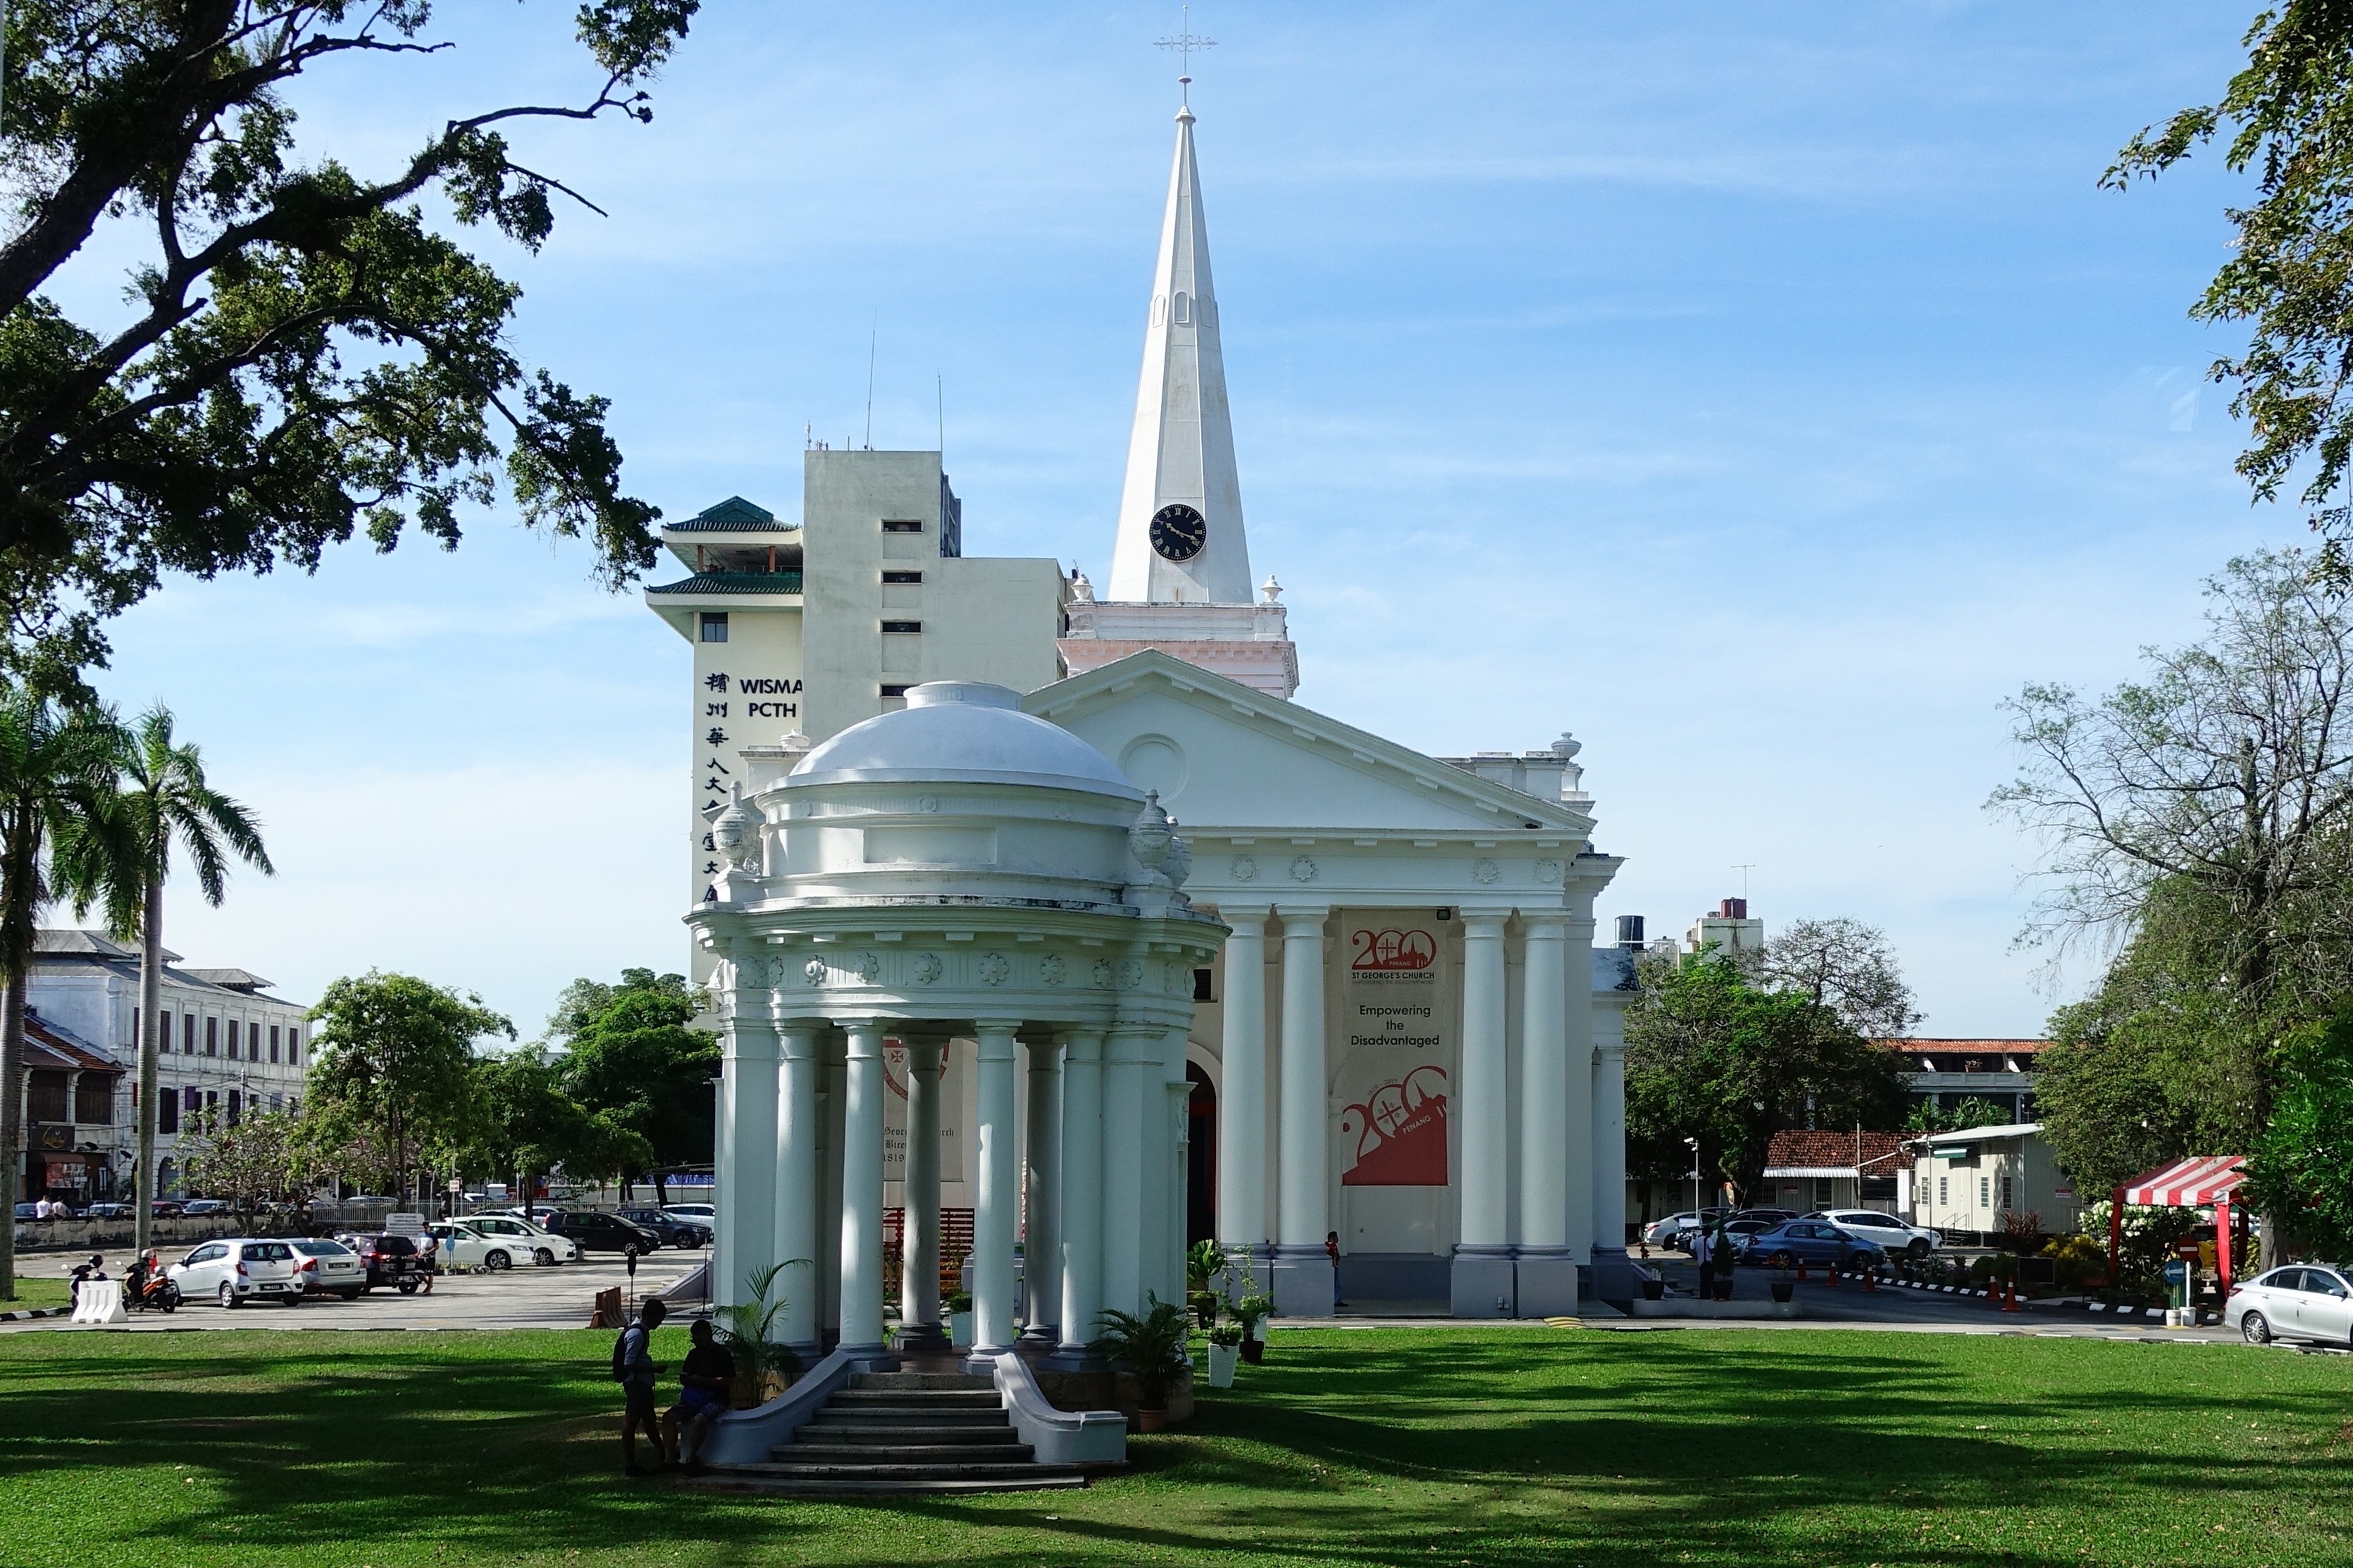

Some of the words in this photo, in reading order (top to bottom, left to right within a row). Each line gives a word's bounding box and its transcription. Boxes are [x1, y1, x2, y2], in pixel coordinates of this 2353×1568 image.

[740, 679, 803, 695] WISMA
[749, 702, 797, 718] PCTH
[1360, 1004, 1431, 1018] Empowering
[1386, 1019, 1404, 1030] the
[1351, 1034, 1439, 1048] Disadvantaged
[1402, 1115, 1432, 1135] PENANG
